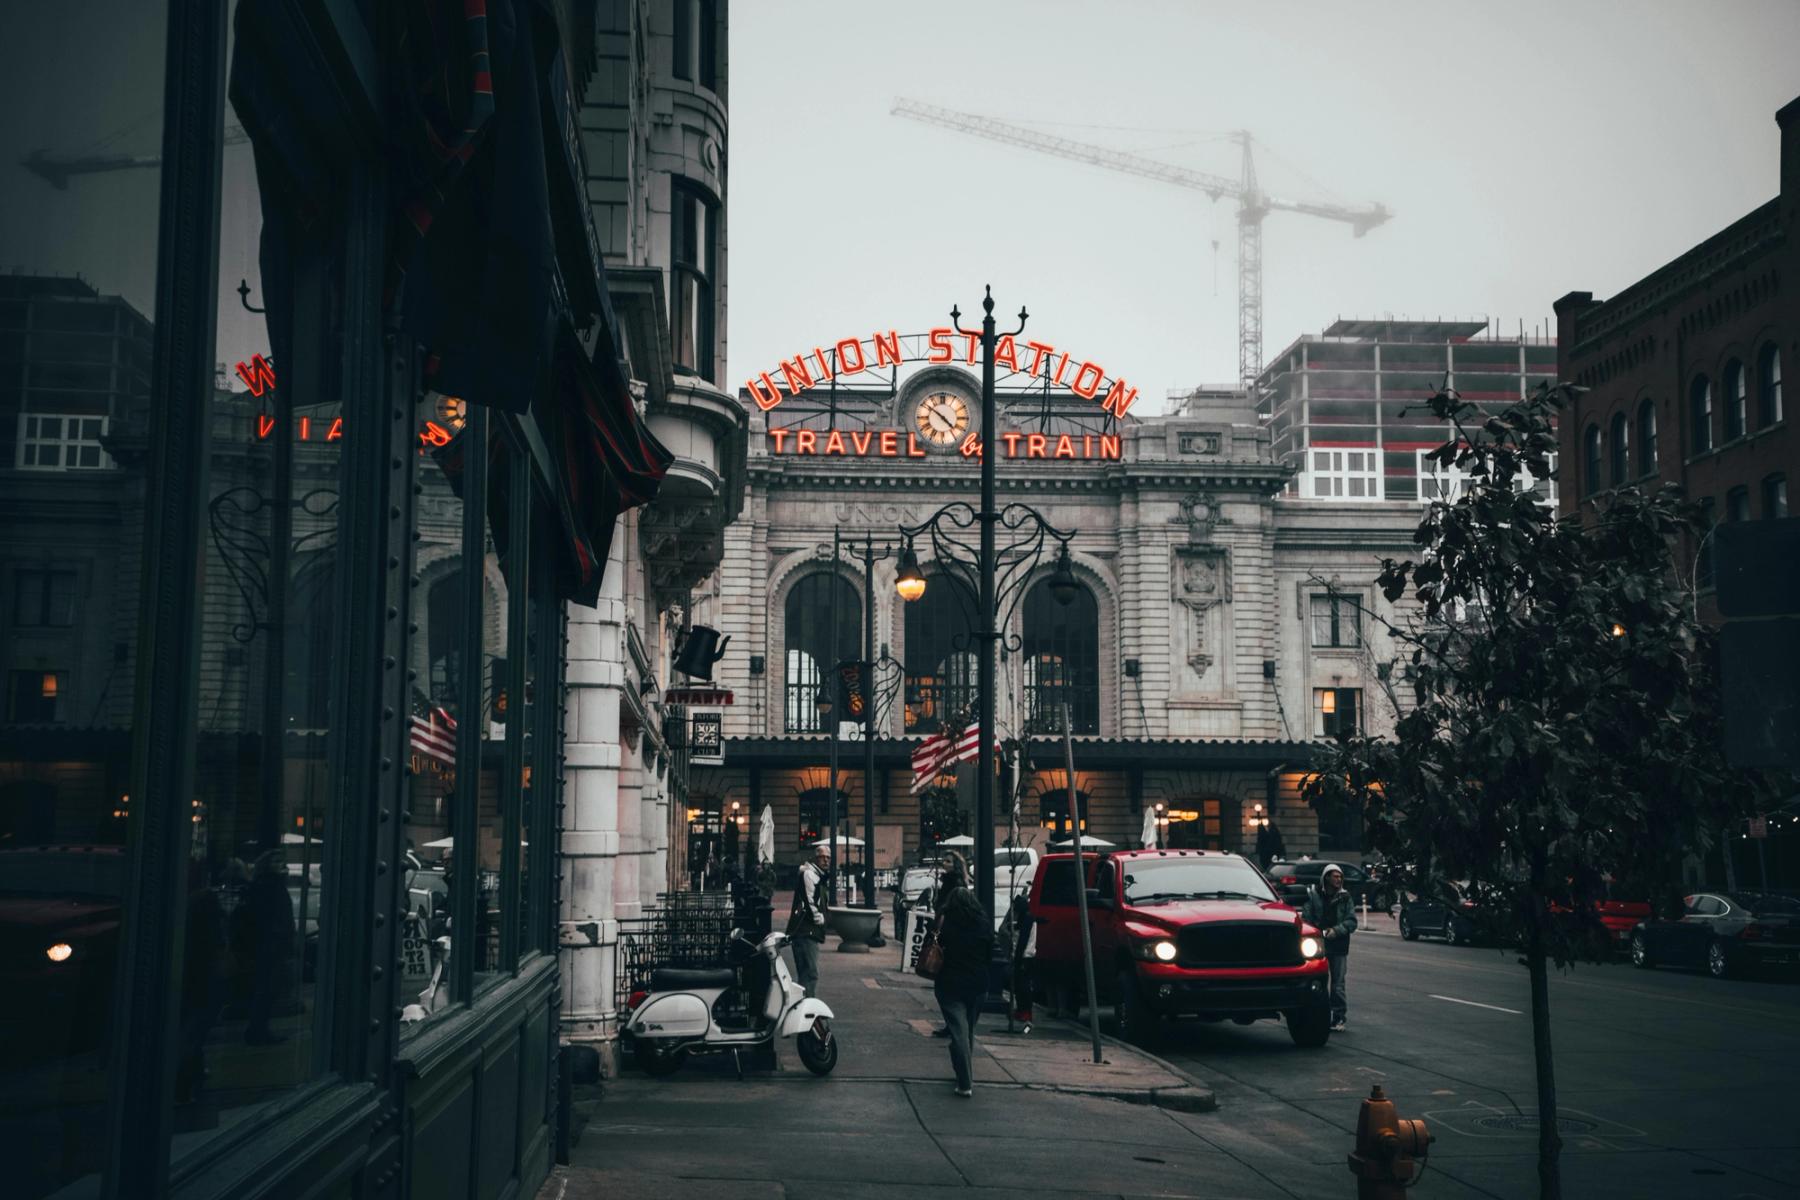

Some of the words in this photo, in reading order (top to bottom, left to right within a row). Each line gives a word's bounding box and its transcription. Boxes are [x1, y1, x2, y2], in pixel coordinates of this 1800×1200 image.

[745, 330, 903, 411] UNION
[928, 328, 1139, 420] STATION
[770, 429, 926, 458] TRAVEL
[1004, 432, 1120, 460] TRAIN
[834, 503, 920, 523] UNION
